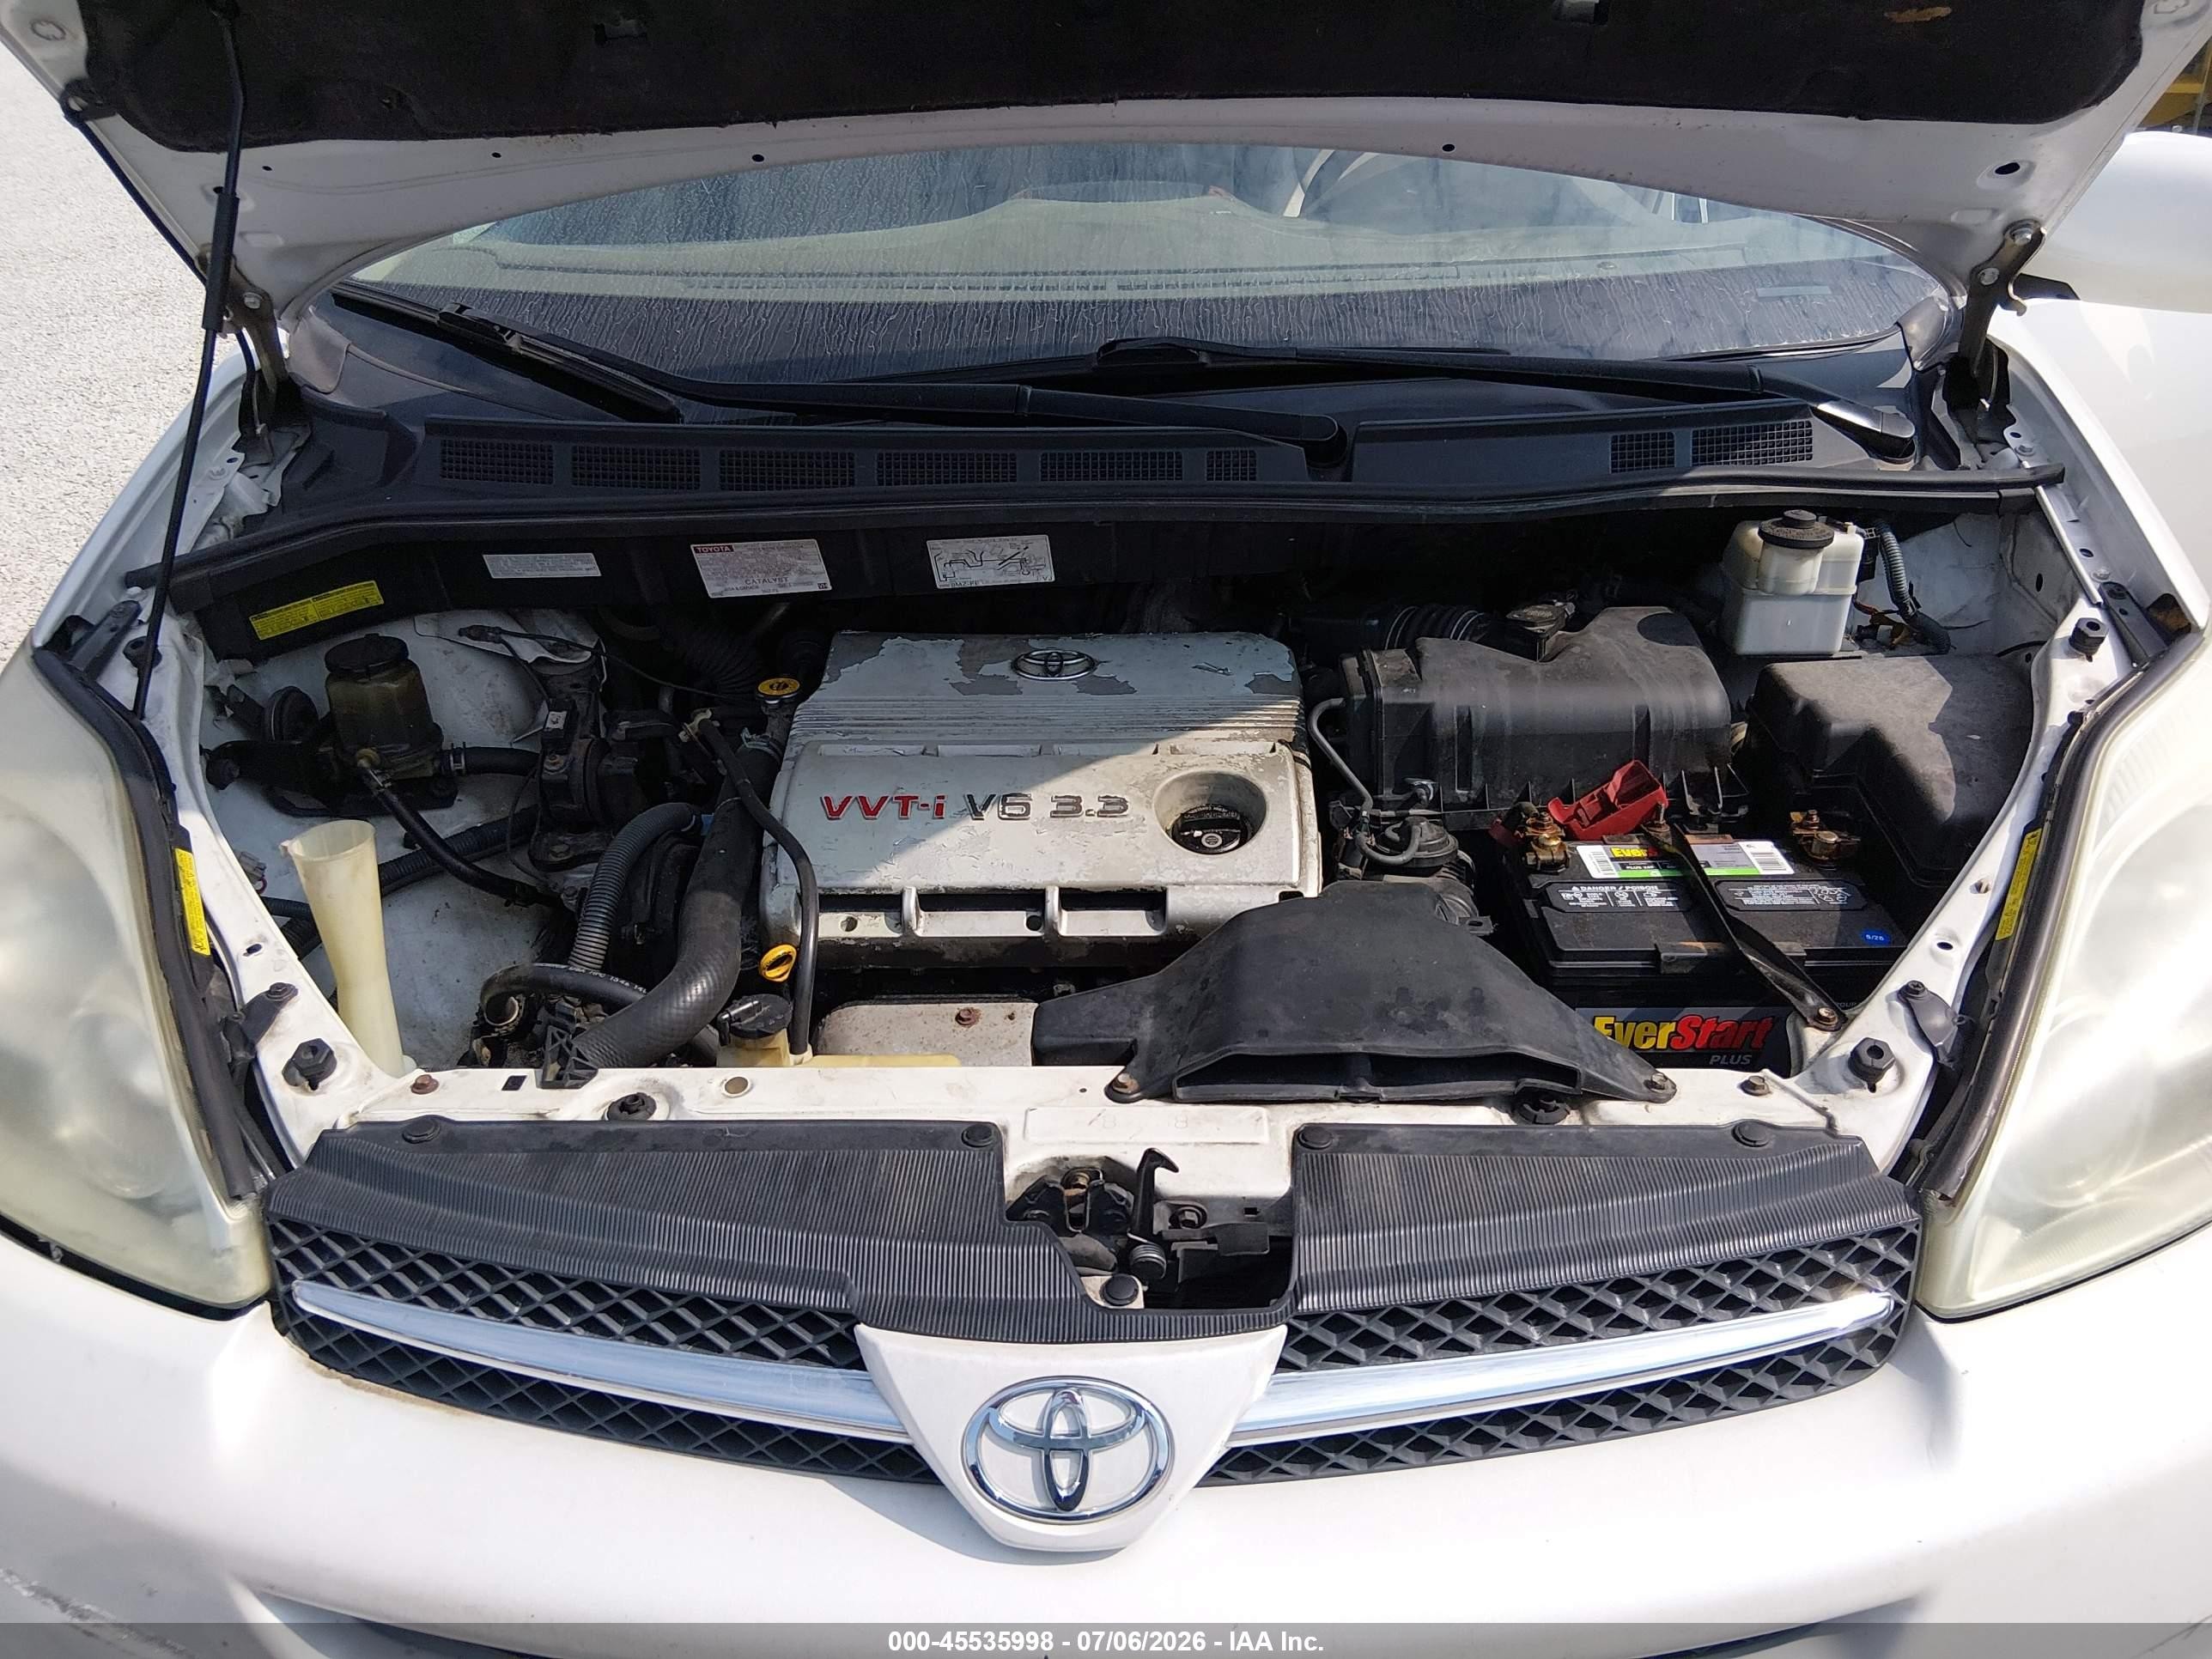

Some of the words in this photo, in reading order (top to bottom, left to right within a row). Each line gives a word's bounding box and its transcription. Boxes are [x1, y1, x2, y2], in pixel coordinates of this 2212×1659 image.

[744, 576, 789, 586] CATALYST
[820, 795, 946, 820] VVT-i
[963, 793, 1032, 820] V6
[1050, 794, 1129, 817] 3.3
[1593, 1014, 1773, 1049] EverStart
[1710, 1054, 1753, 1065] PLUS
